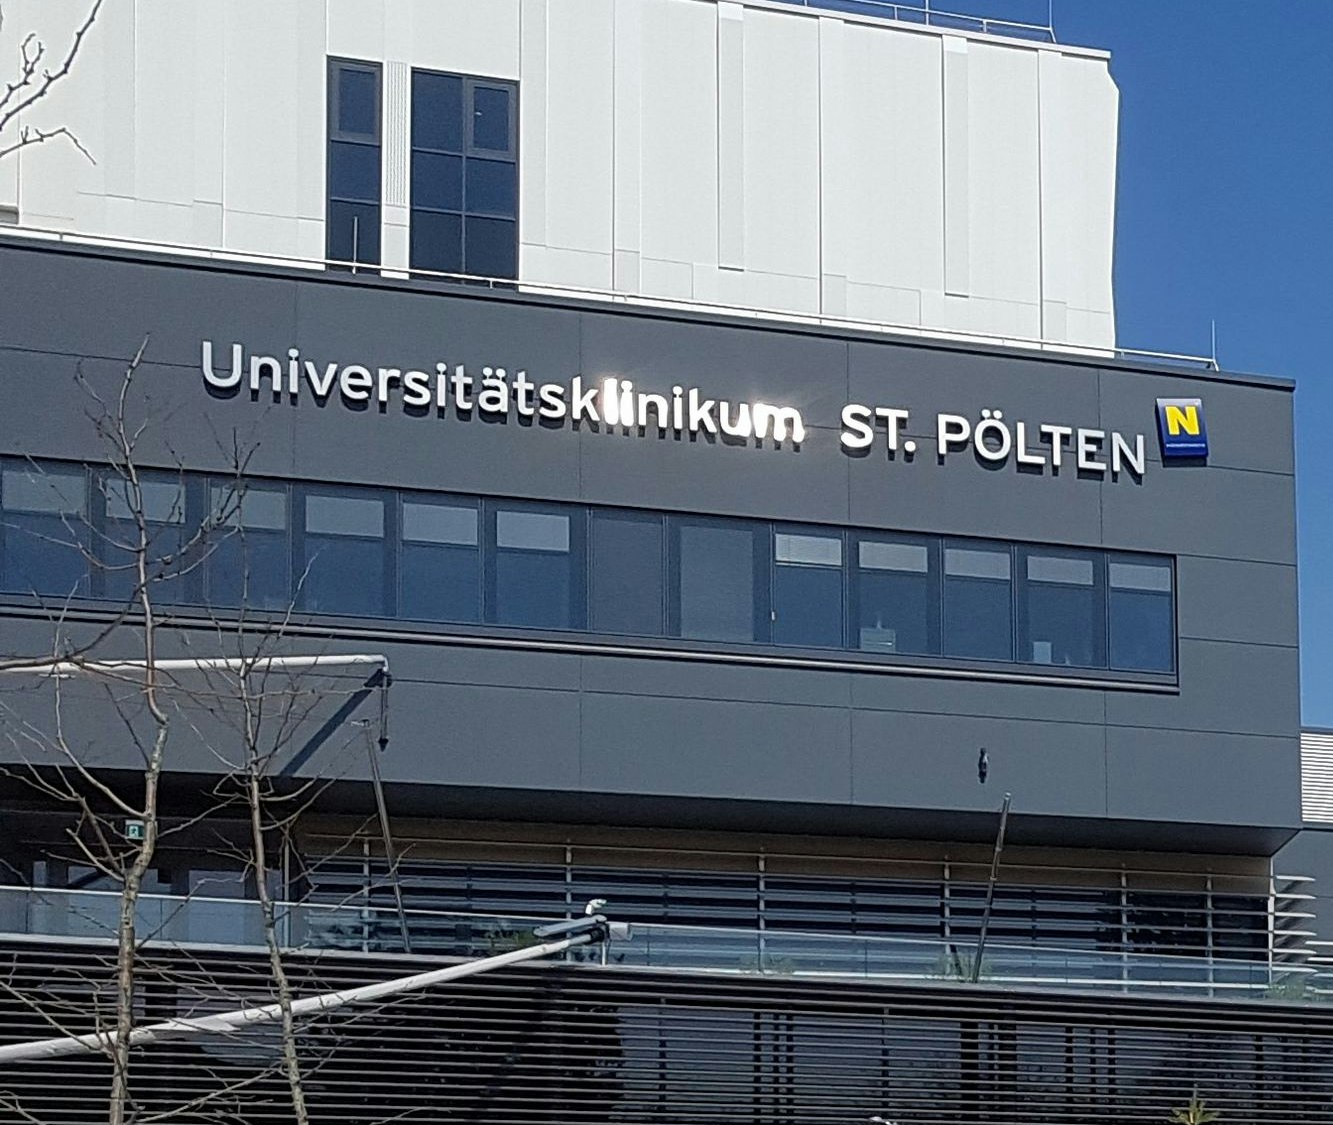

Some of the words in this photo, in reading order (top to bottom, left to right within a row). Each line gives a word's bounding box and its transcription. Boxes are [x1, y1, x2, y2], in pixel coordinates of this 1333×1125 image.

[202, 341, 807, 443] Universitätsklinikum
[840, 403, 917, 453] ST.
[937, 408, 1145, 475] PÖLTEN
[1165, 406, 1200, 435] N
